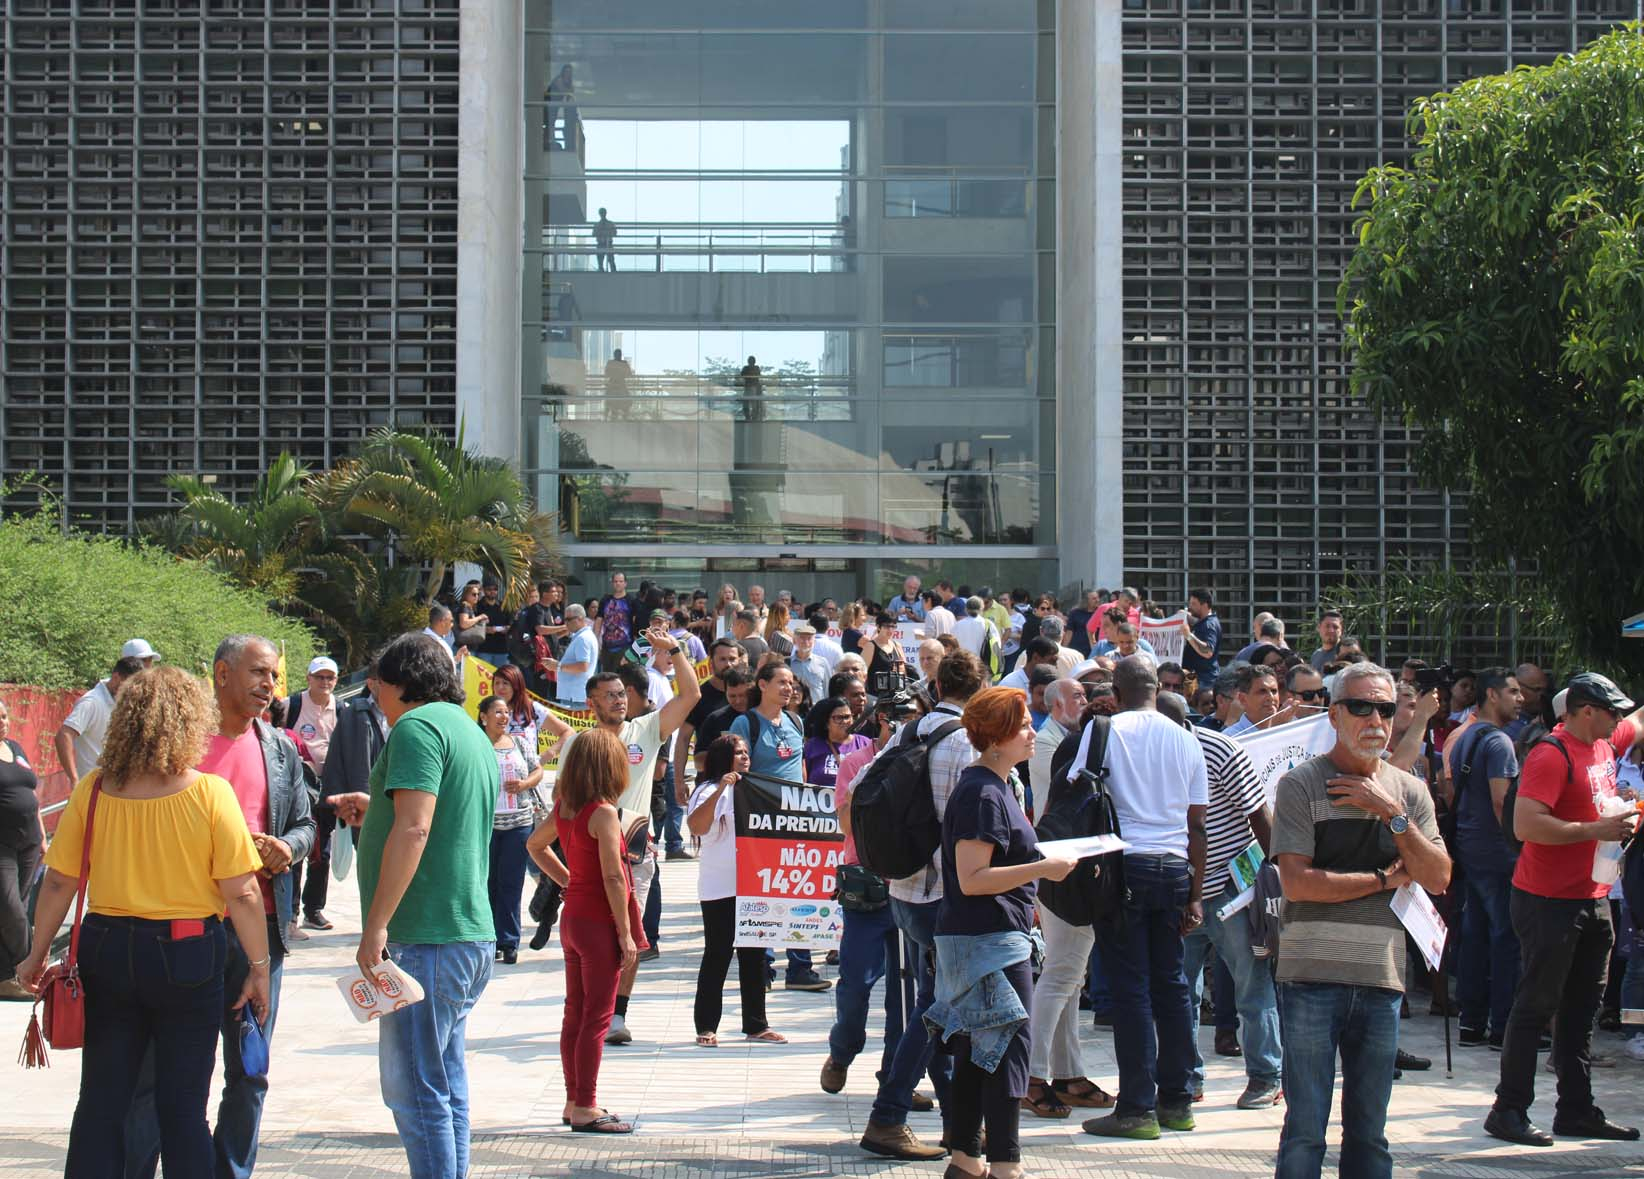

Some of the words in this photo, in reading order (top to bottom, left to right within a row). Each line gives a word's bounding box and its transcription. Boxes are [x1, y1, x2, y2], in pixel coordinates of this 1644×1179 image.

[748, 813, 773, 830] DA
[780, 843, 822, 868] NÃO
[756, 867, 816, 896] 14%
